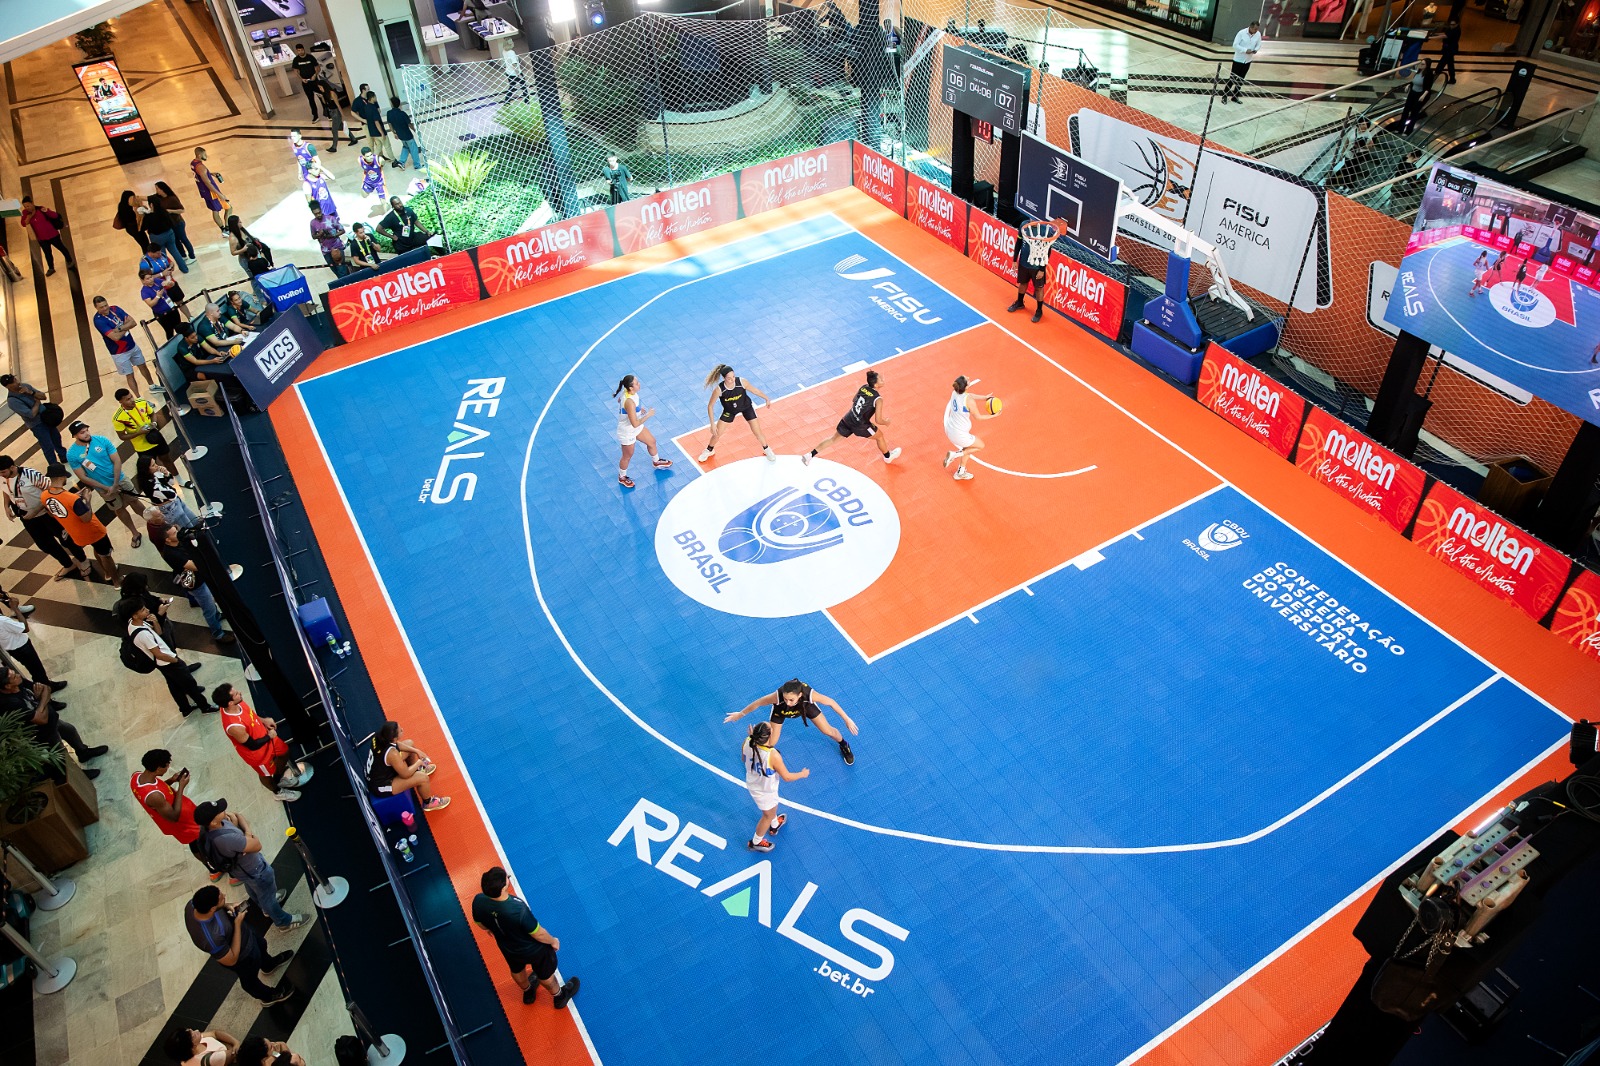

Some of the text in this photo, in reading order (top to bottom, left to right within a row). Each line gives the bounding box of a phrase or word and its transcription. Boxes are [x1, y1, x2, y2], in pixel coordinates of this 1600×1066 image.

[949, 73, 963, 88] 06
[969, 82, 992, 99] 04:06
[998, 93, 1012, 108] 07
[764, 153, 828, 189] molten
[863, 153, 894, 187] molten
[641, 188, 711, 225] molten
[918, 186, 954, 222] molten
[1222, 197, 1270, 229] FISU
[506, 225, 584, 265] molten
[981, 222, 1016, 258] molte
[1162, 230, 1178, 244] 202
[1215, 233, 1236, 251] 3X3
[1219, 217, 1271, 250] AMERICA
[278, 286, 304, 302] molten
[361, 267, 446, 310] molten
[872, 281, 943, 325] FISU
[1056, 262, 1105, 306] molten
[1401, 271, 1425, 316] REALS
[868, 295, 907, 323] AMERICA
[260, 335, 295, 373] MCS
[952, 398, 958, 412] 9
[1220, 363, 1280, 418] molten
[430, 376, 507, 505] REALS
[1323, 429, 1396, 490] molten
[813, 477, 873, 527] CBDU
[1222, 519, 1250, 540] CBDU
[1447, 506, 1534, 576] molten
[673, 529, 732, 594] BRASIL
[1181, 538, 1211, 562] BRASIL
[1436, 537, 1465, 562] feel
[1459, 553, 1479, 570] the
[1252, 573, 1369, 659] DO DESPORTO
[1262, 566, 1356, 637] BRASILEIRA
[1274, 561, 1406, 656] CONFEDERAÇÃO
[1242, 579, 1368, 674] UNIVERSITÁRIO
[366, 748, 374, 774] 8
[606, 797, 911, 982] REALS
[812, 960, 875, 998] .bet.br
